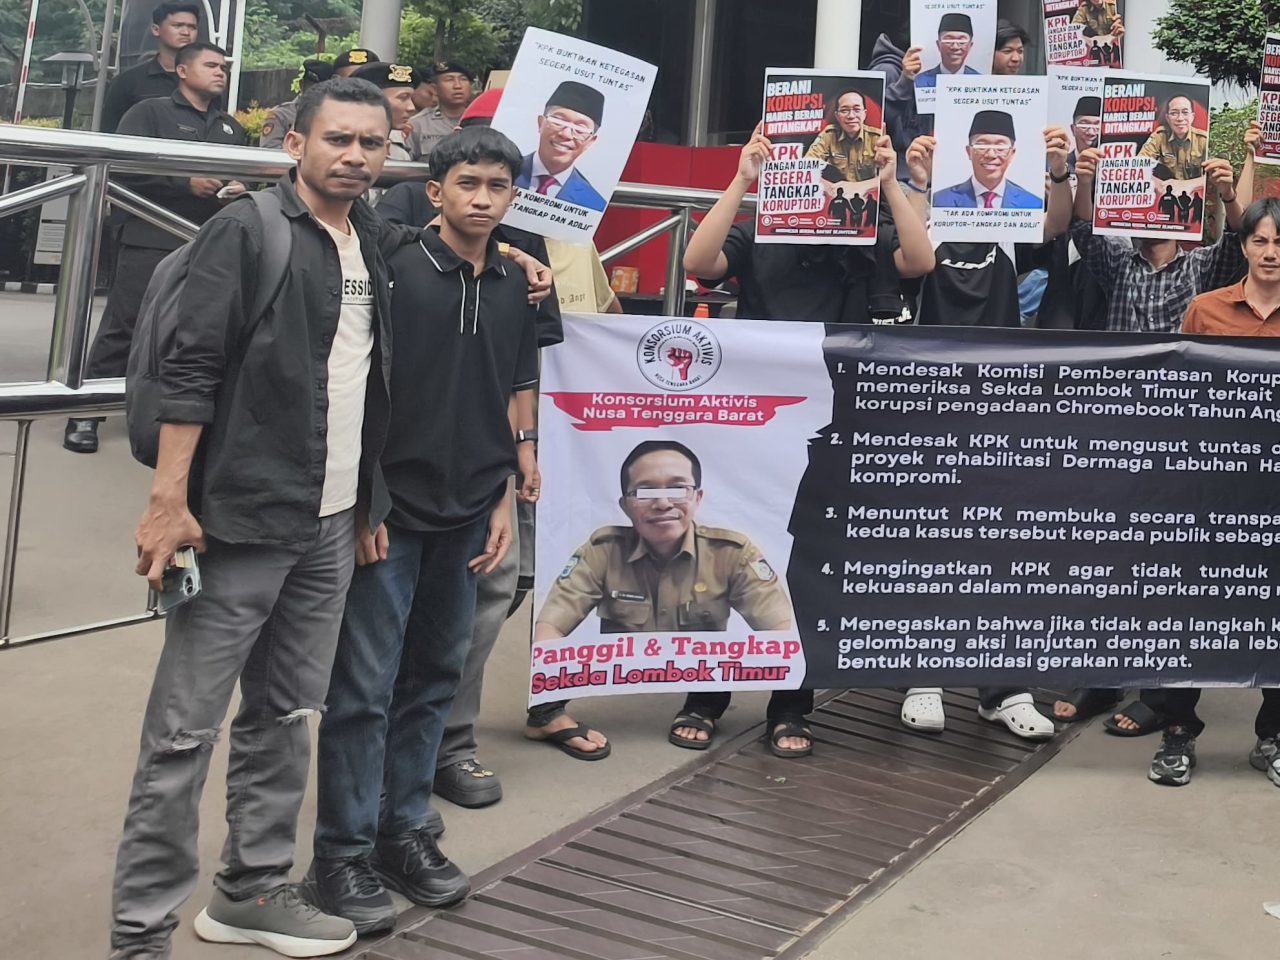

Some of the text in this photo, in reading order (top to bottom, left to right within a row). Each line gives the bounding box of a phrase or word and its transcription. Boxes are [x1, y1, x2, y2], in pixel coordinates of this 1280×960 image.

[1048, 17, 1067, 28] KPK
[1048, 32, 1077, 44] SEGERA
[1049, 40, 1082, 52] TANGKAP
[1050, 48, 1085, 60] KORUPTOR!
[539, 57, 595, 80] SEGERA USUT
[557, 48, 646, 83] BUKTIKAN KETEGASAN
[768, 80, 811, 96] BERANI
[1105, 84, 1145, 97] BERANI
[766, 109, 823, 122] HARUS BERANI
[1104, 112, 1155, 122] HARUS BERANI
[768, 122, 821, 134] DITANGKAP!
[1105, 122, 1153, 133] DITANGKAP!
[767, 146, 798, 161] KPK
[1103, 145, 1132, 158] KPK
[764, 161, 795, 171] JANGAN
[1102, 158, 1129, 167] JANGAN
[764, 171, 812, 185] SEGERA
[1101, 169, 1143, 181] SEGERA
[764, 185, 819, 199] TANGKAP
[1101, 182, 1150, 193] TANGKAP
[524, 193, 588, 217] KOMPROMI UNTUK
[763, 198, 820, 211] KORUPTOR!
[1100, 194, 1151, 205] KORUPTOR!
[550, 214, 566, 223] DAN
[644, 324, 692, 364] KONSORSIUM
[693, 331, 714, 366] AKTIVIS
[838, 363, 845, 373] 1.
[858, 362, 963, 377] Mendesak
[978, 363, 1044, 378] Komisi
[1059, 366, 1212, 382] Pemberantasan
[857, 380, 970, 394] memeriksa
[982, 382, 1042, 395] Sekda
[1054, 383, 1132, 397] Lombok
[1142, 384, 1198, 399] Timur
[1208, 387, 1272, 401] terkait
[592, 393, 757, 408] Konsorsium Aktivis
[856, 396, 932, 413] korupsi
[938, 399, 1050, 415] pengadaan
[1056, 400, 1184, 416] Chromebook
[1189, 404, 1245, 418] Tahun
[583, 407, 763, 422] Nusa Tenggara Barat
[831, 433, 842, 444] 2.
[853, 432, 957, 447] Mendesak
[970, 434, 1009, 448] KPK
[1021, 436, 1078, 449] untuk
[1089, 440, 1188, 454] mengusut
[1199, 441, 1261, 454] tuntas
[852, 451, 923, 467] proyek
[937, 451, 1050, 467] rehabilitasi
[1063, 454, 1152, 472] Dermaga
[1166, 457, 1247, 471] Labuhan
[851, 469, 961, 486] kompromi.
[826, 507, 837, 518] 3.
[848, 506, 949, 520] Menuntut
[963, 507, 1002, 520] KPK
[1017, 508, 1115, 522] membuka
[1130, 513, 1195, 524] secara
[847, 524, 909, 538] kedua
[916, 524, 973, 538] kasus
[979, 526, 1066, 539] tersebut
[1072, 526, 1144, 543] kepada
[1150, 527, 1210, 544] publik
[822, 563, 833, 574] 4.
[845, 560, 991, 578] Mengingatkan
[1011, 562, 1050, 575] KPK
[1069, 566, 1113, 579] agar
[1131, 563, 1181, 577] tidak
[1200, 565, 1268, 578] tunduk
[843, 579, 953, 593] kekuasaan
[959, 579, 1021, 593] dalam
[1027, 580, 1138, 598] menangani
[1143, 582, 1219, 598] perkara
[1225, 585, 1270, 599] yang
[818, 620, 829, 631] 5.
[841, 616, 970, 634] Menegaskan
[977, 616, 1044, 630] bahwa
[1047, 616, 1084, 637] jika
[1091, 616, 1141, 631] tidak
[1148, 617, 1182, 631] ada
[1190, 617, 1265, 635] langkah
[839, 635, 955, 653] gelombang
[966, 634, 1006, 649] aksi
[1016, 633, 1096, 652] lanjutan
[1107, 635, 1180, 653] dengan
[1190, 635, 1239, 649] skala
[532, 636, 800, 666] Panggil & Tangkap
[838, 652, 1191, 671] bentuk konsolidasi gerakan rakyat.
[532, 661, 790, 694] Sekda Lombok Timur
